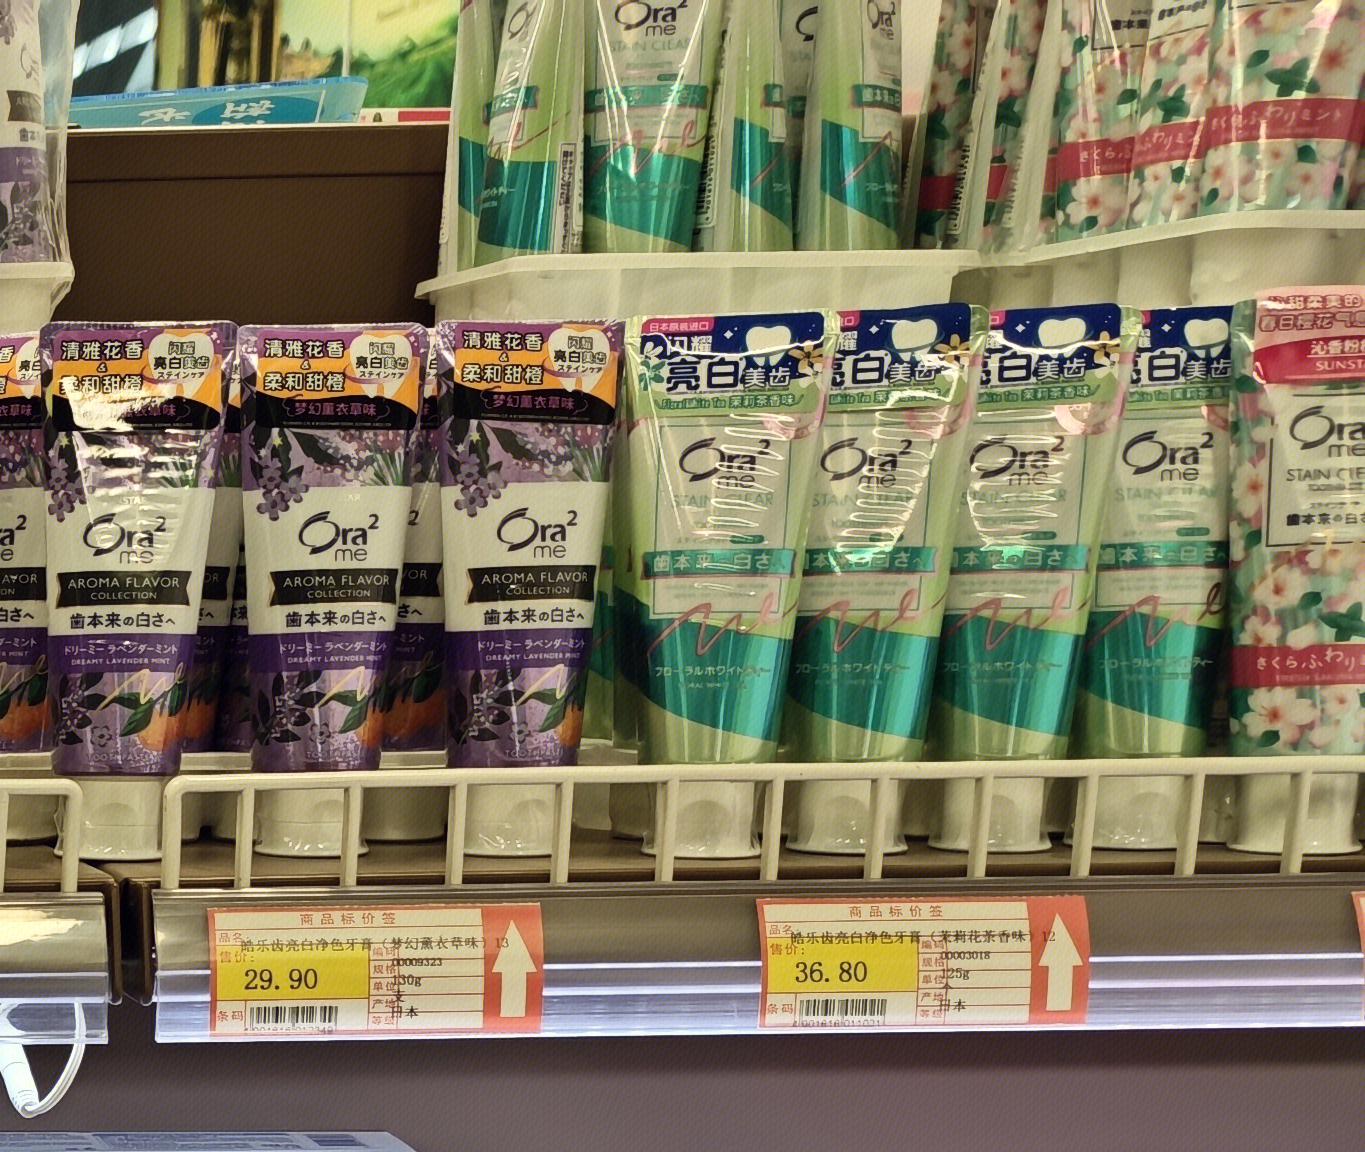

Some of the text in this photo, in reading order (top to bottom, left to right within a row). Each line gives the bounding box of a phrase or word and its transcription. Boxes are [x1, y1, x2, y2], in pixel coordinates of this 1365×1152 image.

[462, 331, 544, 352] 清雅花香
[463, 364, 543, 384] 柔和甜橙
[482, 572, 588, 586] AROMA FLAVOR
[505, 586, 570, 596] COLLECTION
[484, 608, 586, 626] 歯本来の白さへ
[477, 638, 586, 651] ドリーミー ラベンダーミント
[485, 653, 519, 663] DREAMY
[849, 906, 943, 917] 商品标价签
[300, 913, 396, 925] 商品标价签
[244, 968, 318, 990] 29.90
[795, 961, 868, 983] 36.80
